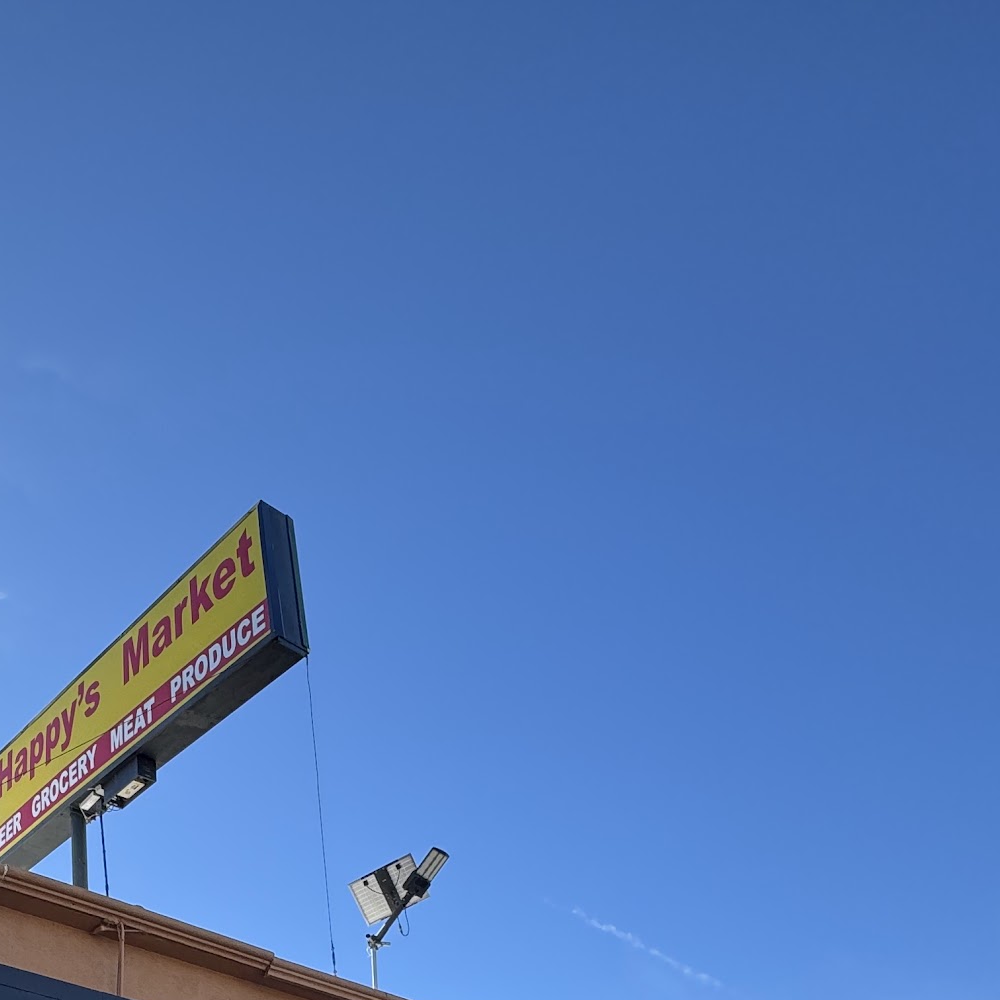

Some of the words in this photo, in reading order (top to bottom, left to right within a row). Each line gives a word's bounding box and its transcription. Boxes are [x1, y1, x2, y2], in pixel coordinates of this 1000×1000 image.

[123, 527, 256, 686] Market
[31, 744, 98, 818] GROCERY
[110, 696, 156, 753] MEAT
[170, 604, 266, 703] PRODUCE
